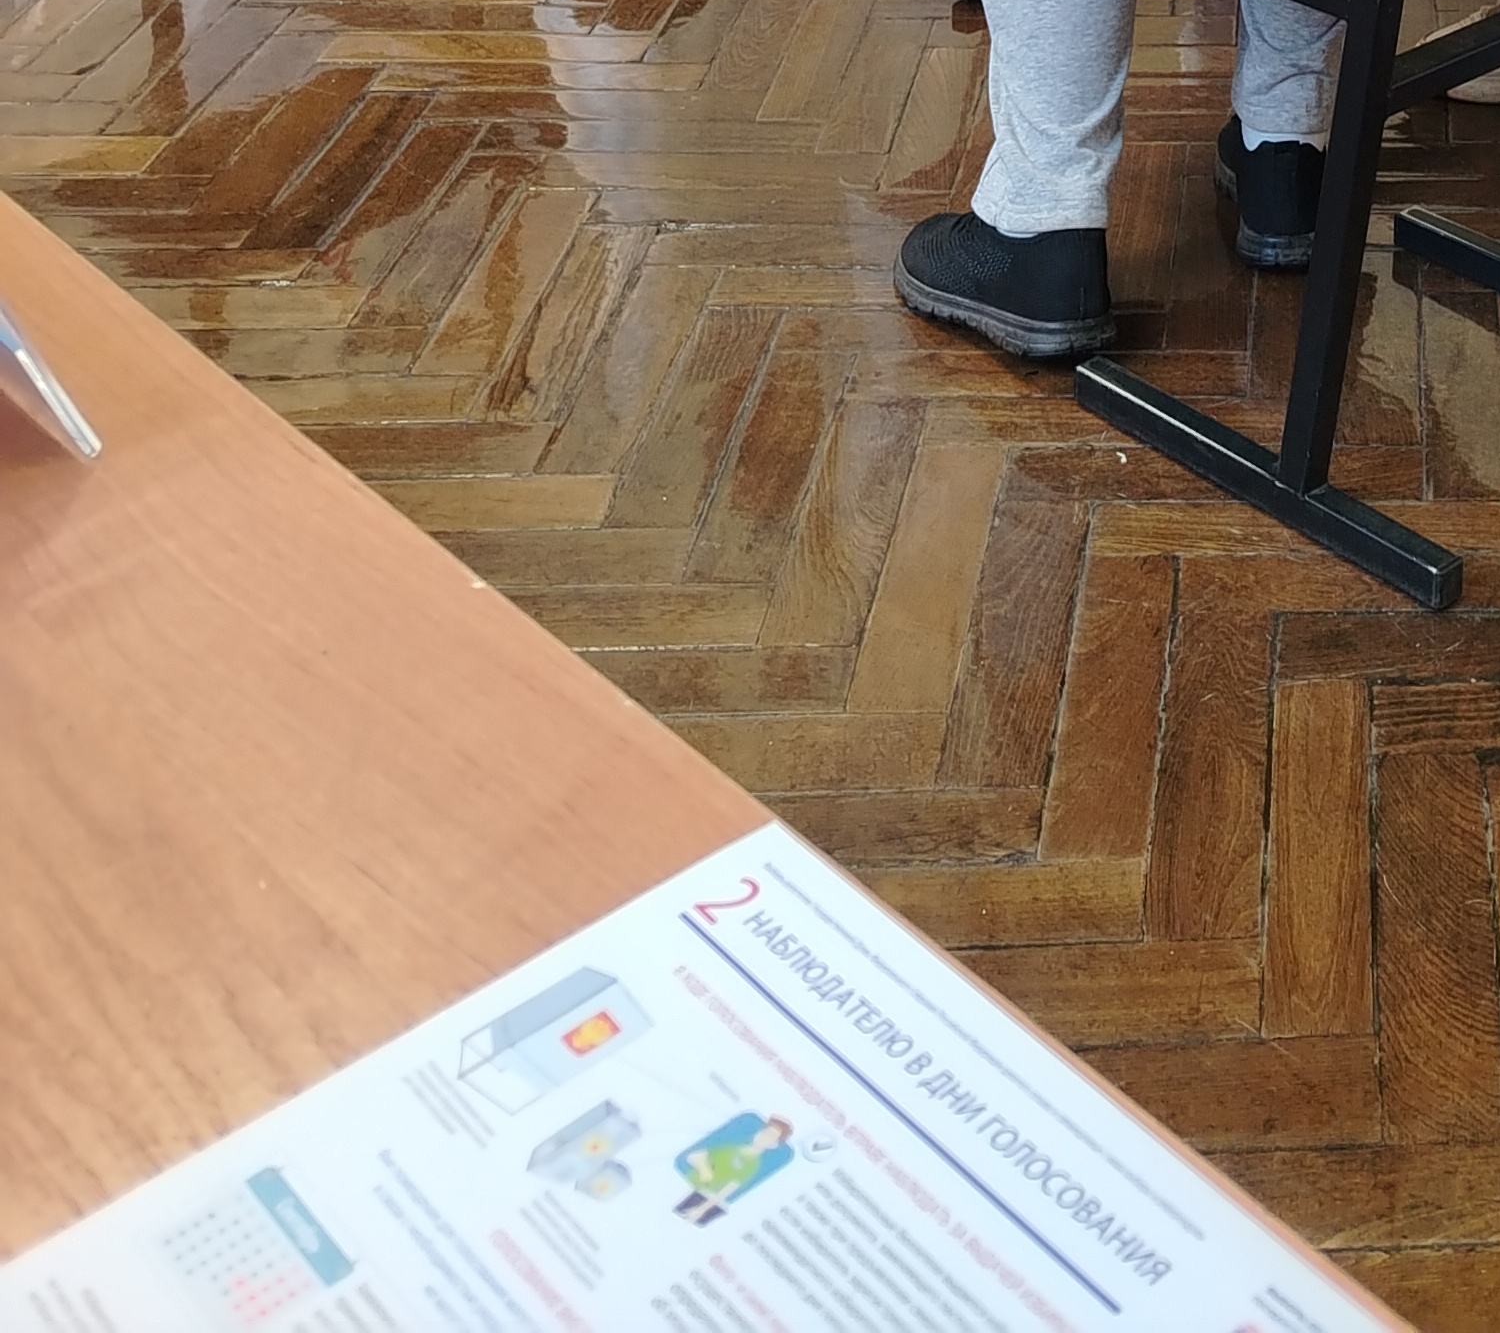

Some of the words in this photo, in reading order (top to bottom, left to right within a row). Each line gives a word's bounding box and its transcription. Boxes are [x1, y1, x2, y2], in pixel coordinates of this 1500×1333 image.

[692, 876, 760, 925] 2
[742, 909, 914, 1060] НАБЛЮДАТЕЛЮ
[904, 1050, 933, 1076] В
[916, 1069, 987, 1124] ДНИ
[976, 1113, 1173, 1287] ГОЛОСОВАНИЯ
